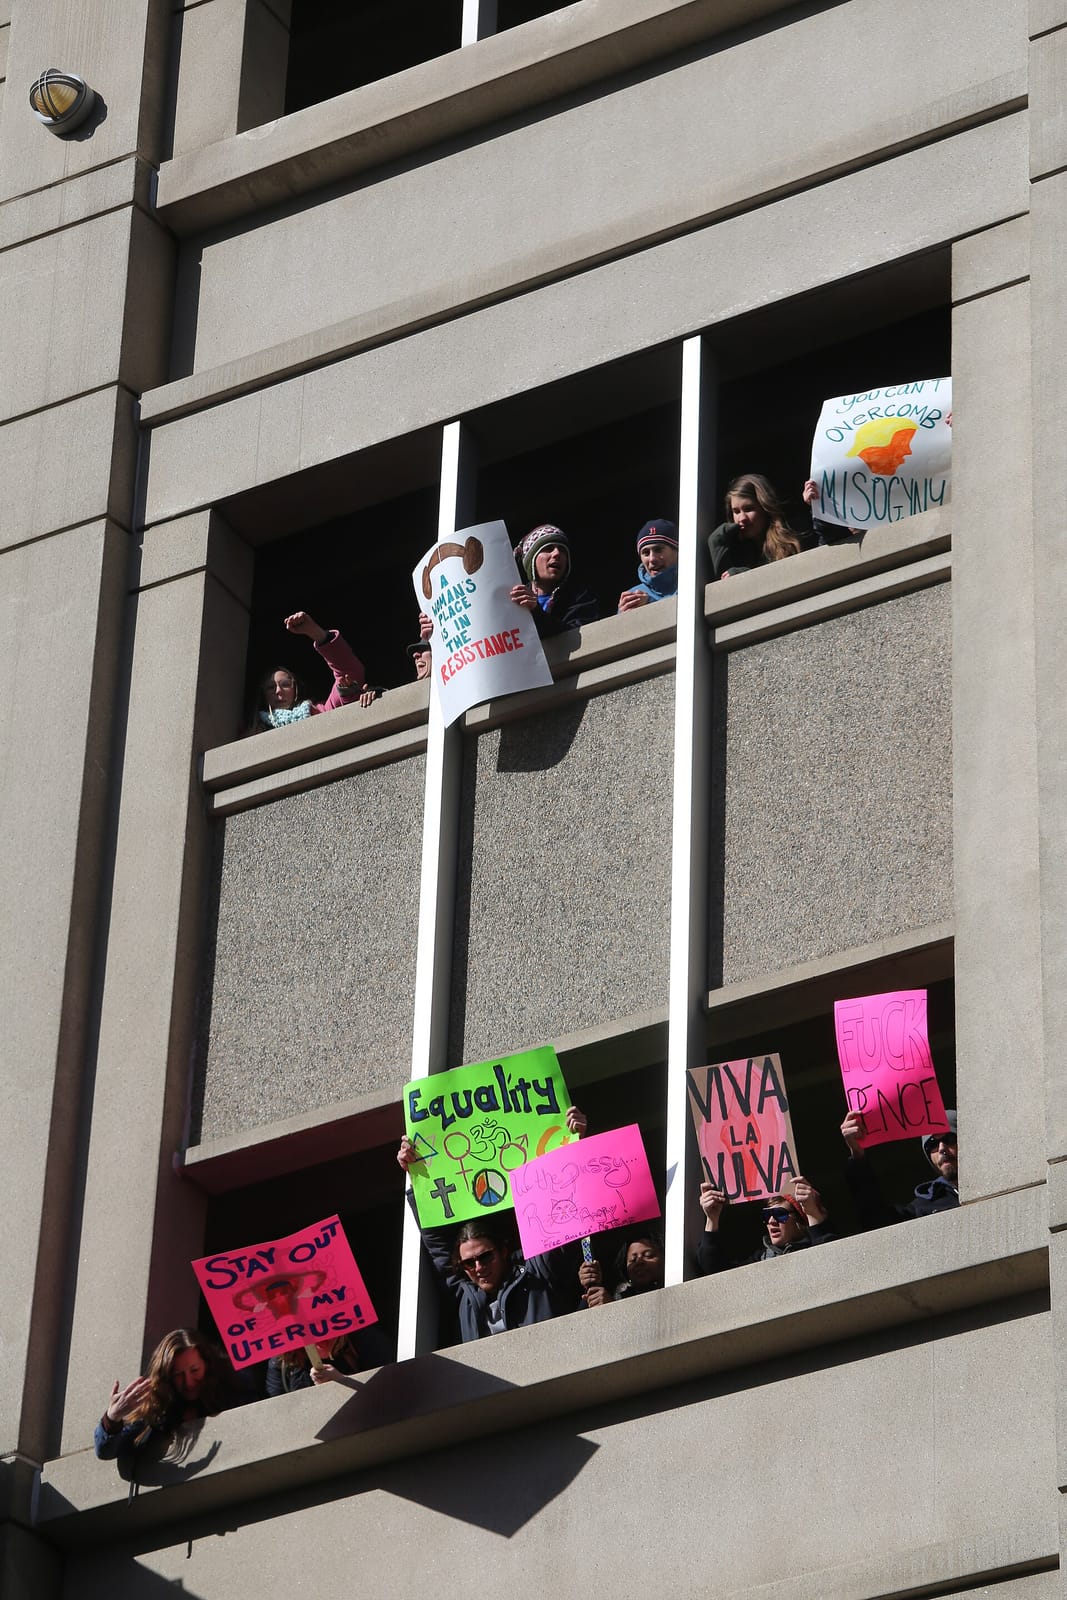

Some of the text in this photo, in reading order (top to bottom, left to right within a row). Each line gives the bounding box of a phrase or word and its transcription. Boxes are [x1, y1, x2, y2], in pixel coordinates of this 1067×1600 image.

[821, 469, 946, 523] MISOGYNY
[431, 578, 477, 616] WOMAN'S
[439, 574, 449, 589] A
[438, 595, 472, 626] PLACE
[441, 613, 471, 642] IS IN
[440, 628, 524, 686] RESISTANCE
[446, 630, 471, 653] THE
[837, 998, 932, 1073] FUCK
[408, 1064, 561, 1131] Equality
[686, 1056, 789, 1123] VIVA
[847, 1077, 945, 1136] PENCE
[729, 1122, 758, 1146] LA
[702, 1142, 797, 1200] VULVA
[205, 1221, 340, 1289] STAY OUT
[227, 1285, 347, 1336] OF MY
[231, 1304, 366, 1361] UTERUS!
